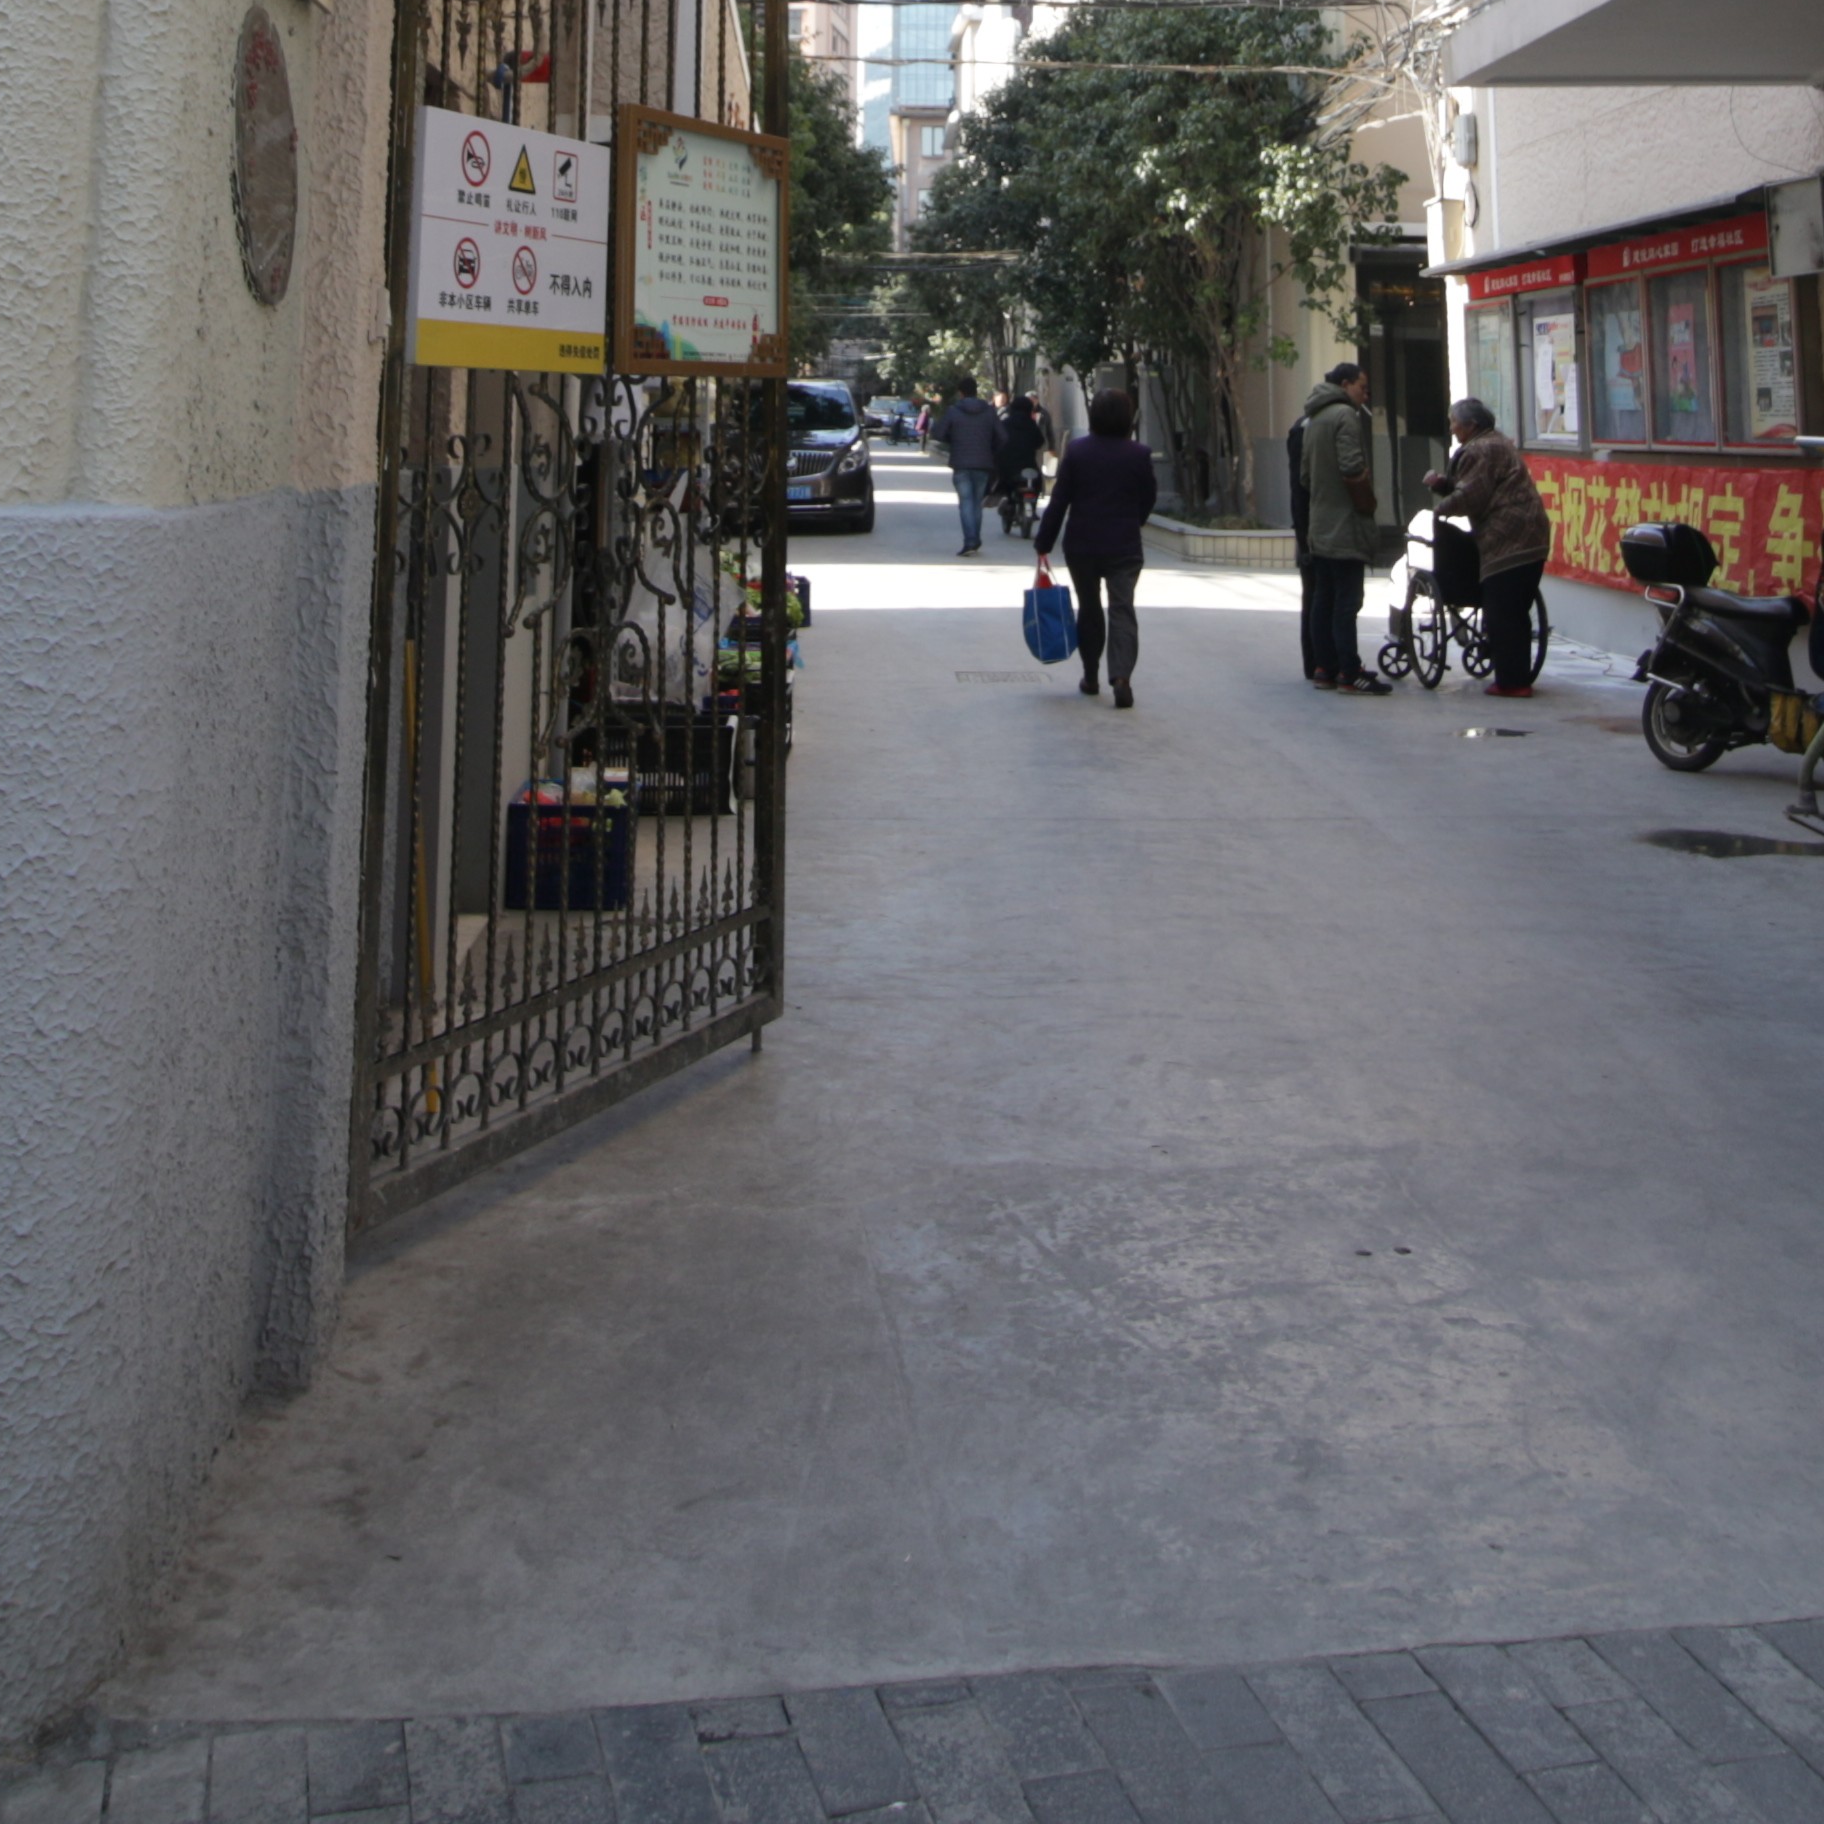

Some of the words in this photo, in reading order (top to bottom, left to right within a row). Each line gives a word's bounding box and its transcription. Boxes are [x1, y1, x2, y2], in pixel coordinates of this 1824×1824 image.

[506, 198, 538, 217] 礼让行人
[549, 273, 593, 299] 不得入内
[438, 291, 492, 312] 非本小区车辆
[506, 298, 540, 316] 共享单车
